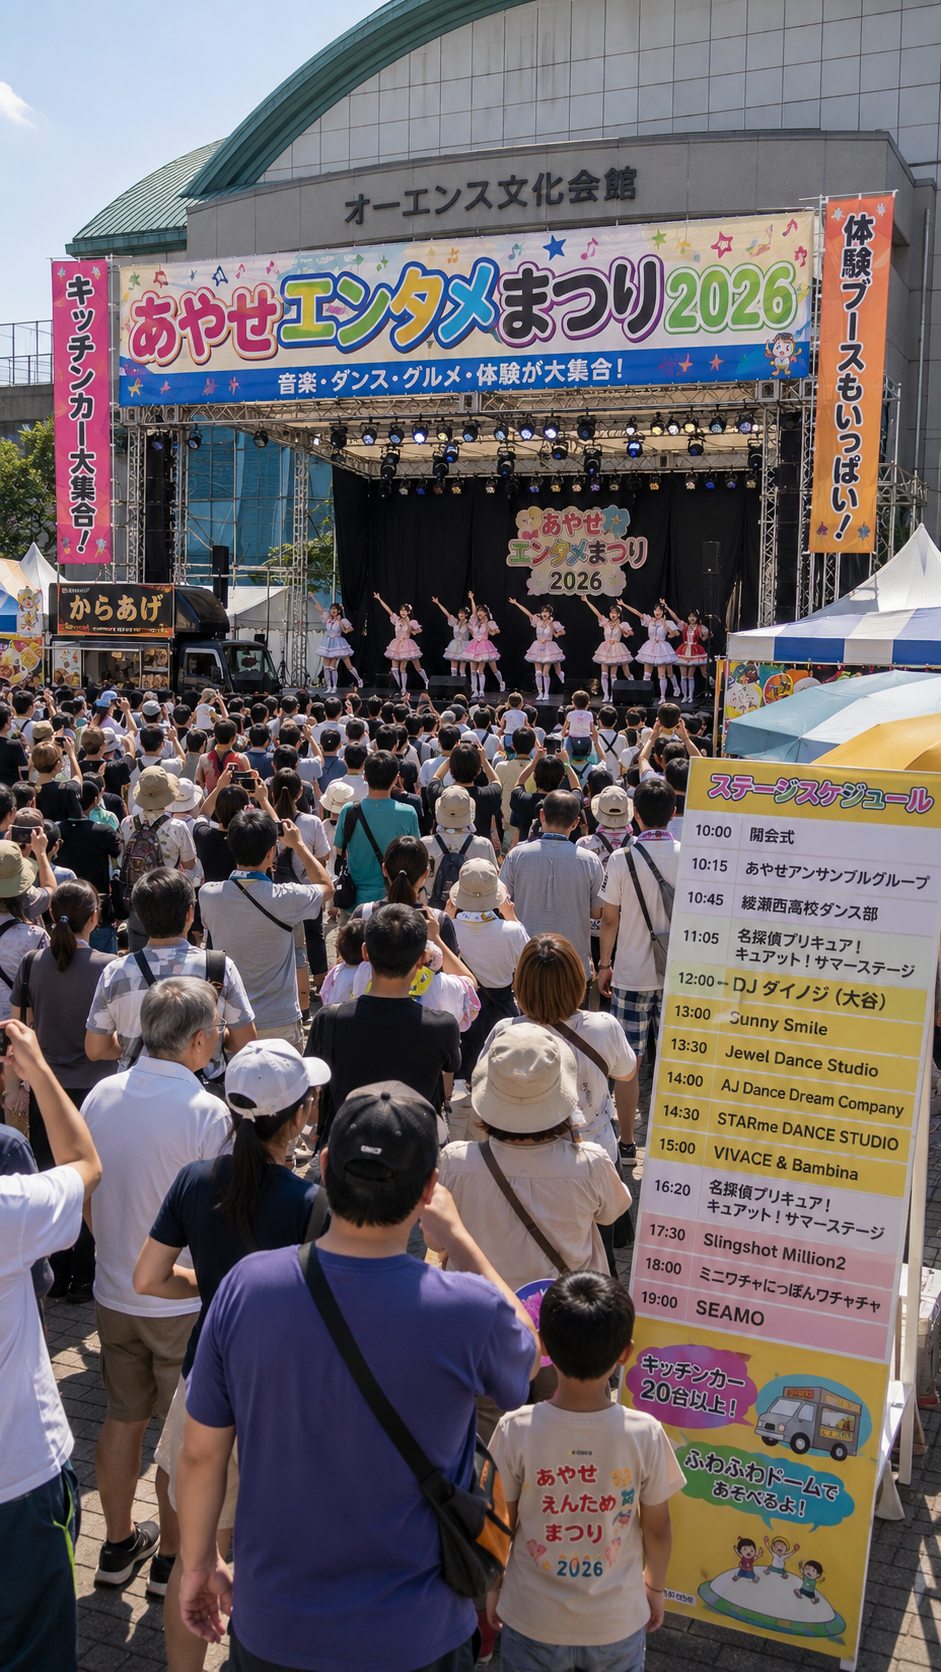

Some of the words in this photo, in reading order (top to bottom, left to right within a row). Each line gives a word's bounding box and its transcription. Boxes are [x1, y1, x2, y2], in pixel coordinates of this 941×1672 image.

[345, 166, 637, 225] オーエンス文化会館
[277, 358, 623, 395] 音楽・ダンス・グルメ・体験が大集合！
[832, 214, 875, 543] 体験ブースもいっぱい！
[67, 275, 97, 553] キッチンカー大集合！
[541, 512, 603, 536] あやせ
[510, 539, 644, 565] エンタメまつり
[550, 571, 602, 590] 2026
[69, 594, 164, 622] からあげ
[708, 774, 934, 814] ステージスケジュール
[695, 824, 732, 839] 10:00
[750, 827, 795, 845] 開会式
[691, 857, 728, 873] 10:15
[745, 861, 931, 890] あやせアンサンブルグループ
[687, 891, 724, 906] 10:45
[741, 895, 879, 922] 綾瀬西高校ダンス部
[683, 930, 719, 945] 11:05
[737, 928, 862, 954] 名探偵プリキュア！
[678, 972, 715, 987] 12:00
[733, 977, 758, 994] DJ
[674, 1004, 711, 1021] 13:00
[730, 1010, 779, 1032] Sunny
[783, 1017, 828, 1036] Smile
[670, 1037, 708, 1055] 13:30
[725, 1045, 770, 1063] Jewel
[774, 1051, 823, 1070] Dance
[827, 1058, 879, 1077] Studio
[666, 1071, 704, 1088] 14:00
[721, 1079, 740, 1094] AJ
[743, 1081, 786, 1100] Dance
[789, 1087, 835, 1107] Dream
[838, 1094, 904, 1119] Company
[663, 1104, 701, 1122] 14:30
[717, 1111, 779, 1134] STARme
[782, 1121, 836, 1143] DANCE
[838, 1129, 900, 1152] STUDIO
[659, 1137, 696, 1155] 15:00
[713, 1145, 772, 1168] VIVACE
[776, 1155, 787, 1170] &
[791, 1158, 859, 1182] Bambina
[654, 1179, 691, 1197] 16:20
[708, 1178, 831, 1213] 名探偵プリキュア！
[649, 1223, 686, 1242] 17:30
[703, 1232, 778, 1260] Slingshot
[782, 1246, 847, 1271] Million2
[645, 1257, 682, 1275] 18:00
[641, 1291, 678, 1309] 19:00
[699, 1266, 881, 1314] ミニワチャにっぽんワチャチャ
[695, 1299, 765, 1326] SEAMO
[641, 1353, 746, 1389] キッチンカー
[641, 1379, 737, 1418] 20台以上！
[536, 1464, 597, 1487] あやせ
[684, 1450, 839, 1501] ふわふわドームで
[541, 1493, 617, 1514] えんため
[712, 1480, 806, 1517] あそべるよ！
[545, 1523, 603, 1544] まつり
[556, 1559, 603, 1577] 2026
